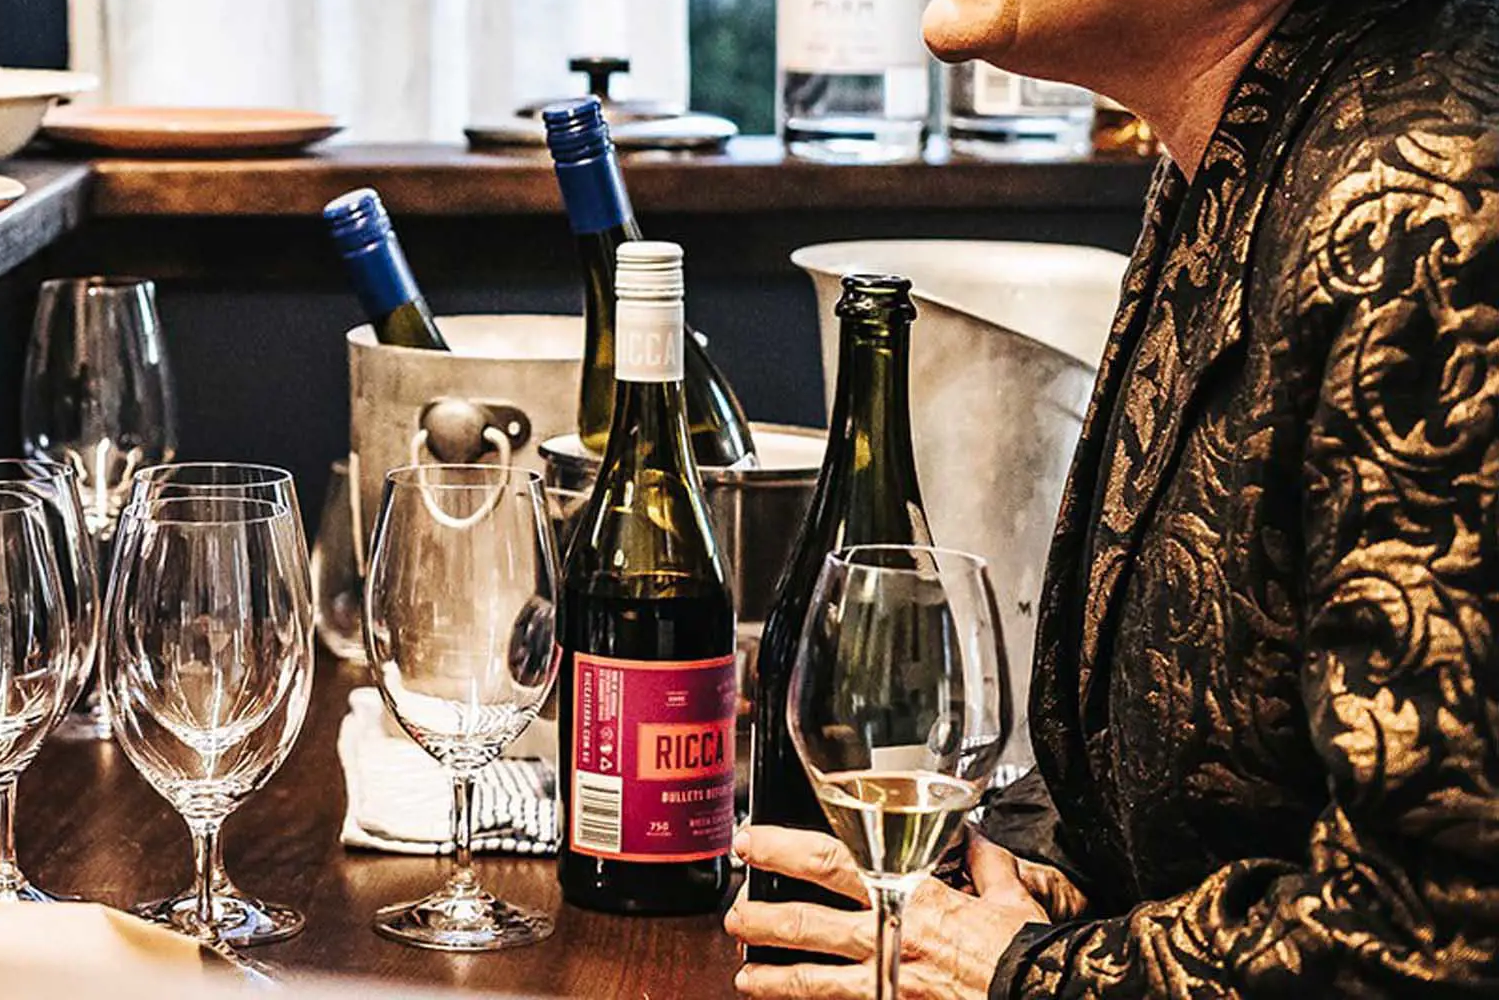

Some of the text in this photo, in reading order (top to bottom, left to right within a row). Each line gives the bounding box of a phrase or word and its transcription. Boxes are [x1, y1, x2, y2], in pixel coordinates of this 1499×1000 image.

[618, 331, 676, 366] ICCA
[656, 732, 723, 769] RICCA
[648, 821, 668, 832] 750
